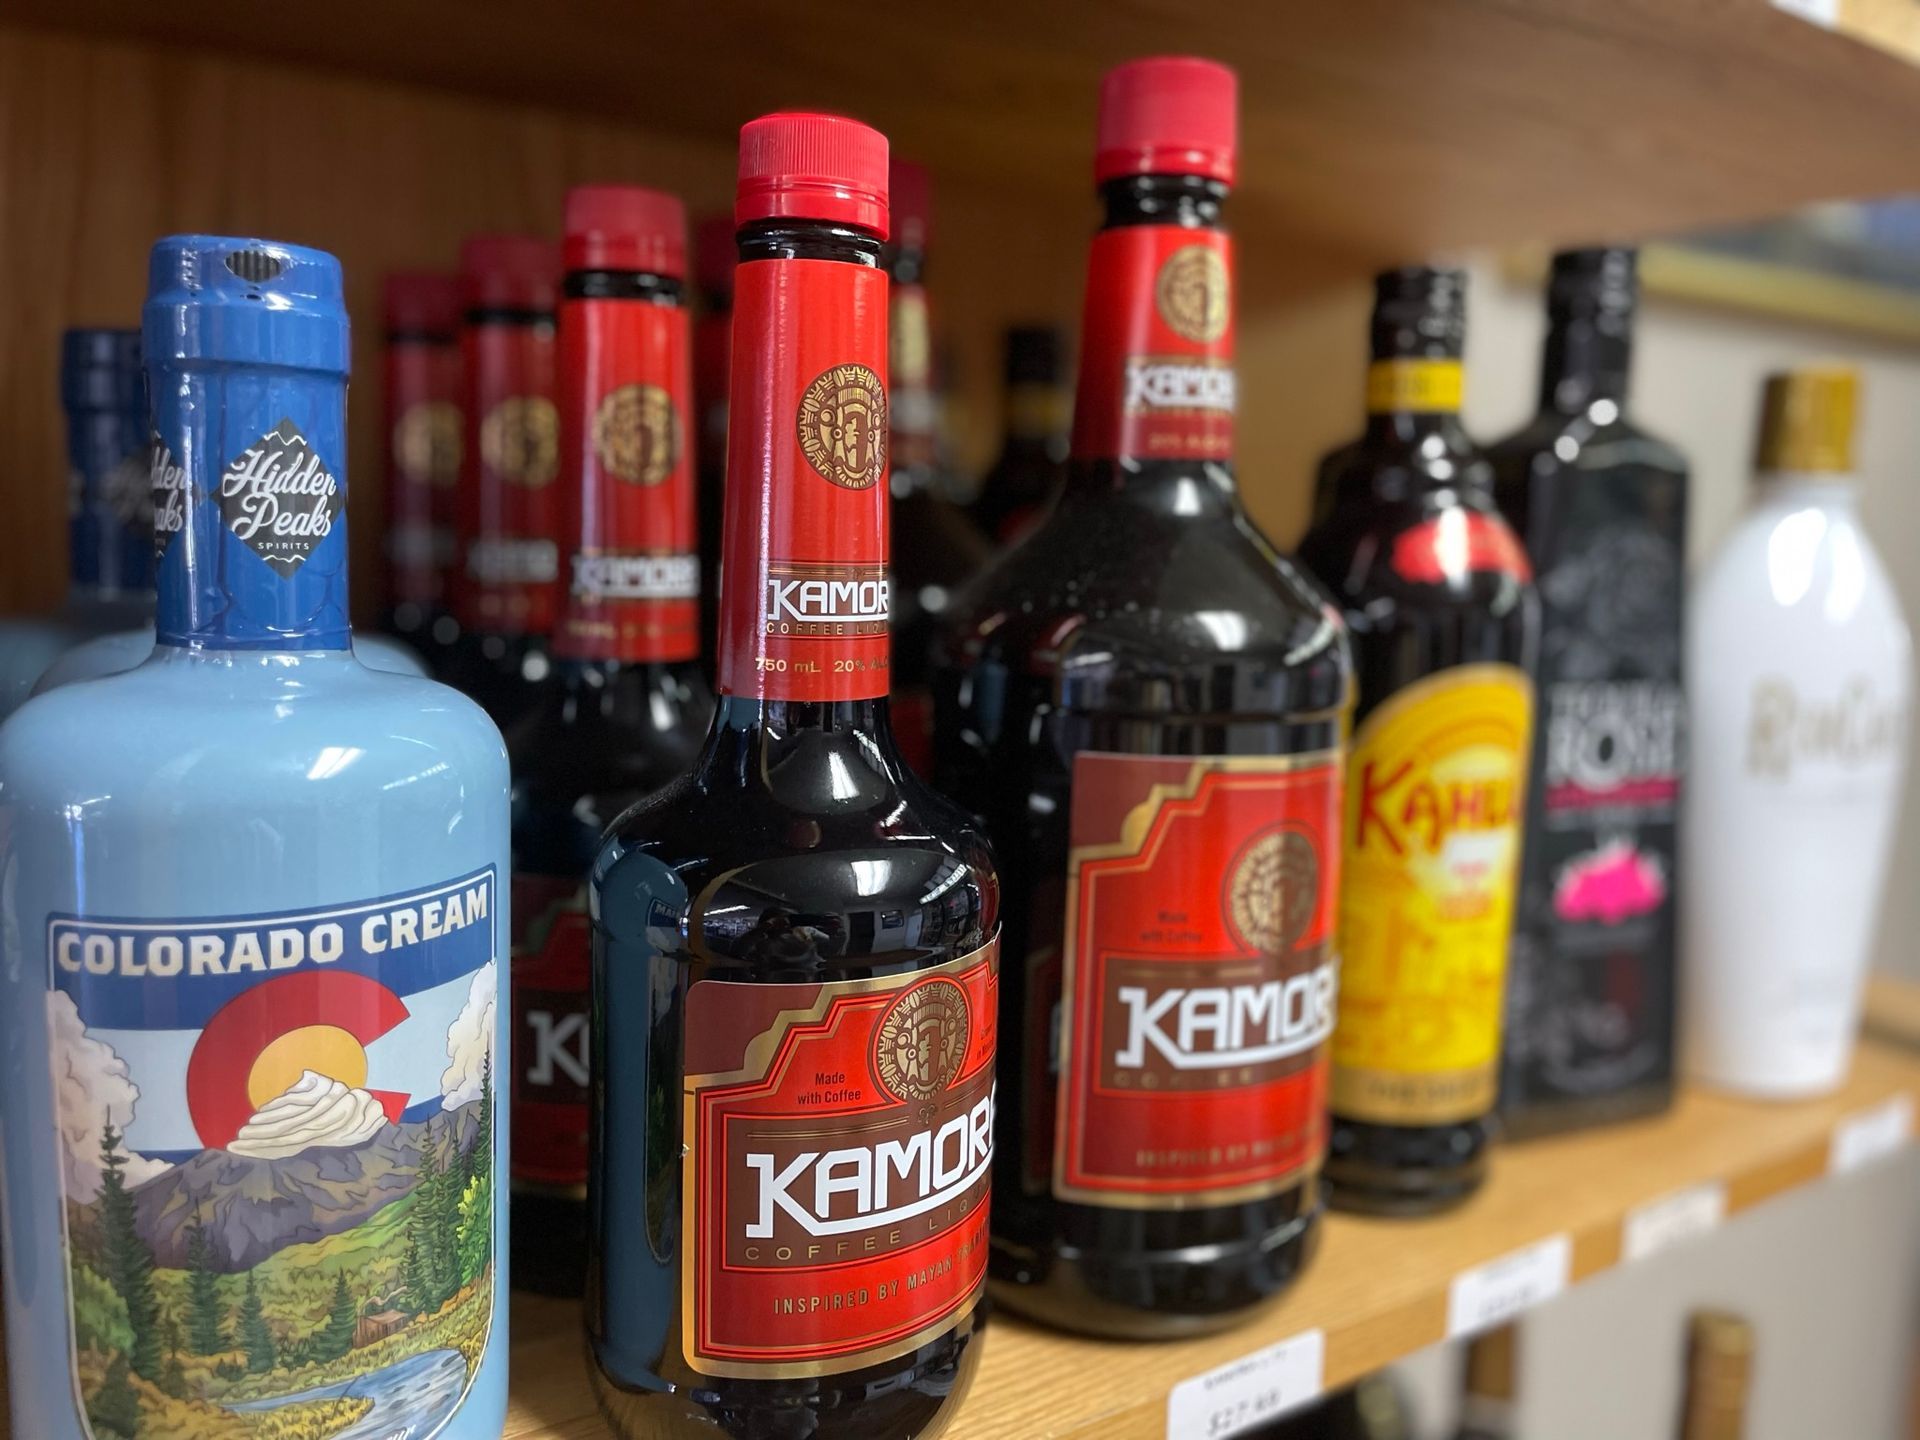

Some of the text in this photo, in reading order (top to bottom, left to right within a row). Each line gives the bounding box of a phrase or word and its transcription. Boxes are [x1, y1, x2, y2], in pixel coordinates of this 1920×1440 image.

[222, 449, 337, 497] Hidden
[231, 493, 333, 541] Peaks
[257, 542, 310, 550] SPIRITS
[766, 623, 843, 635] COFFEE
[755, 658, 787, 672] 750
[794, 661, 821, 673] mL
[834, 659, 866, 673] 20%
[58, 882, 489, 977] COLORADO CREAM
[1114, 957, 1340, 1069] KAMOR
[815, 1071, 845, 1086] Made
[798, 1089, 862, 1105] with Coffee
[745, 1229, 901, 1261] COFFEE
[773, 1289, 869, 1315] INSPIRED
[878, 1279, 899, 1301] BY
[906, 1255, 953, 1290] MAYAN
